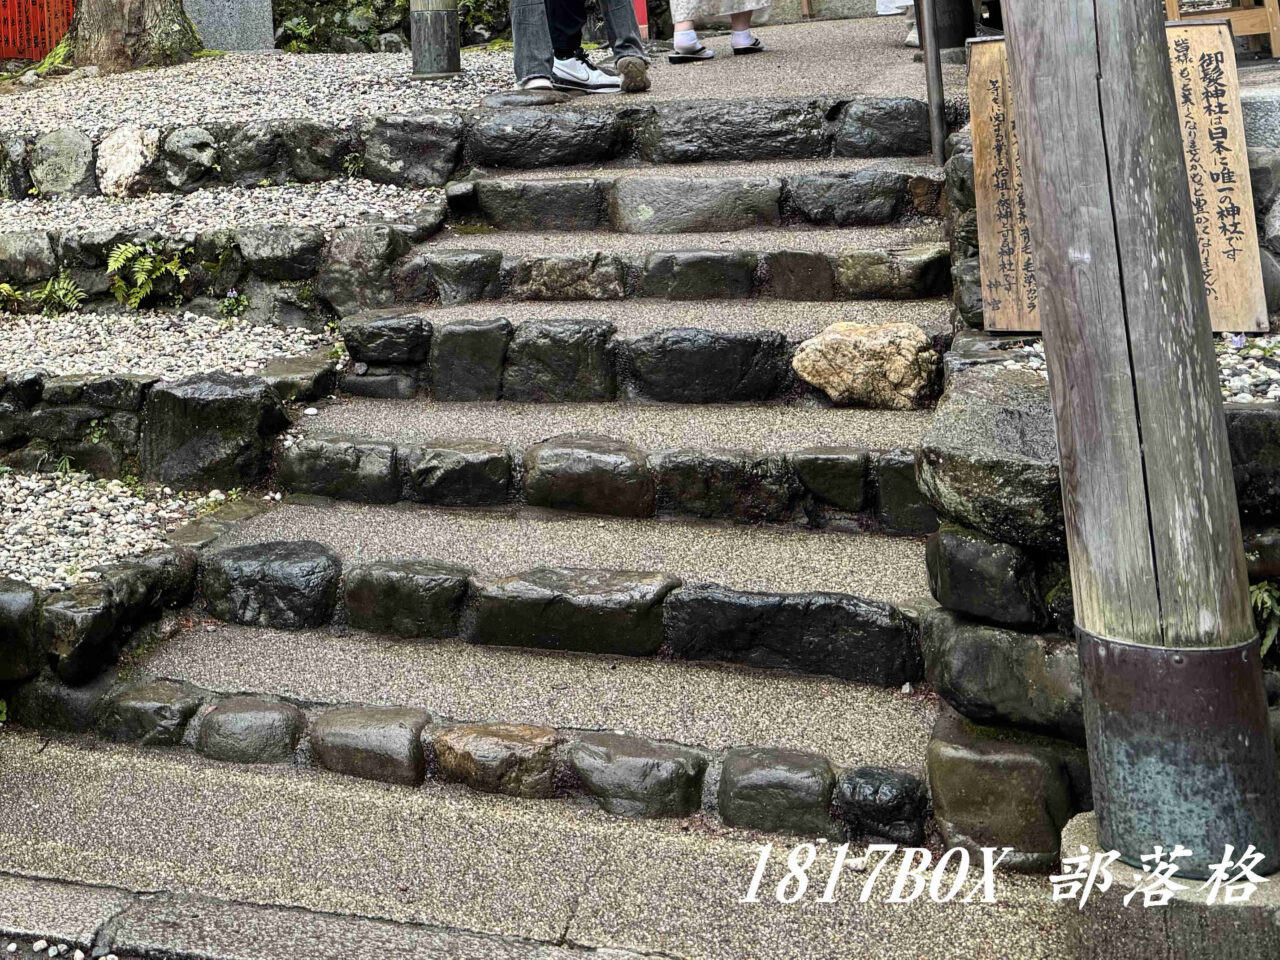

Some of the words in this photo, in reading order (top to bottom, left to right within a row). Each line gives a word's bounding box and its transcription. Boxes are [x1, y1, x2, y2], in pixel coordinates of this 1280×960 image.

[1198, 50, 1245, 262] 御髪神社は日本に唯一の神社です
